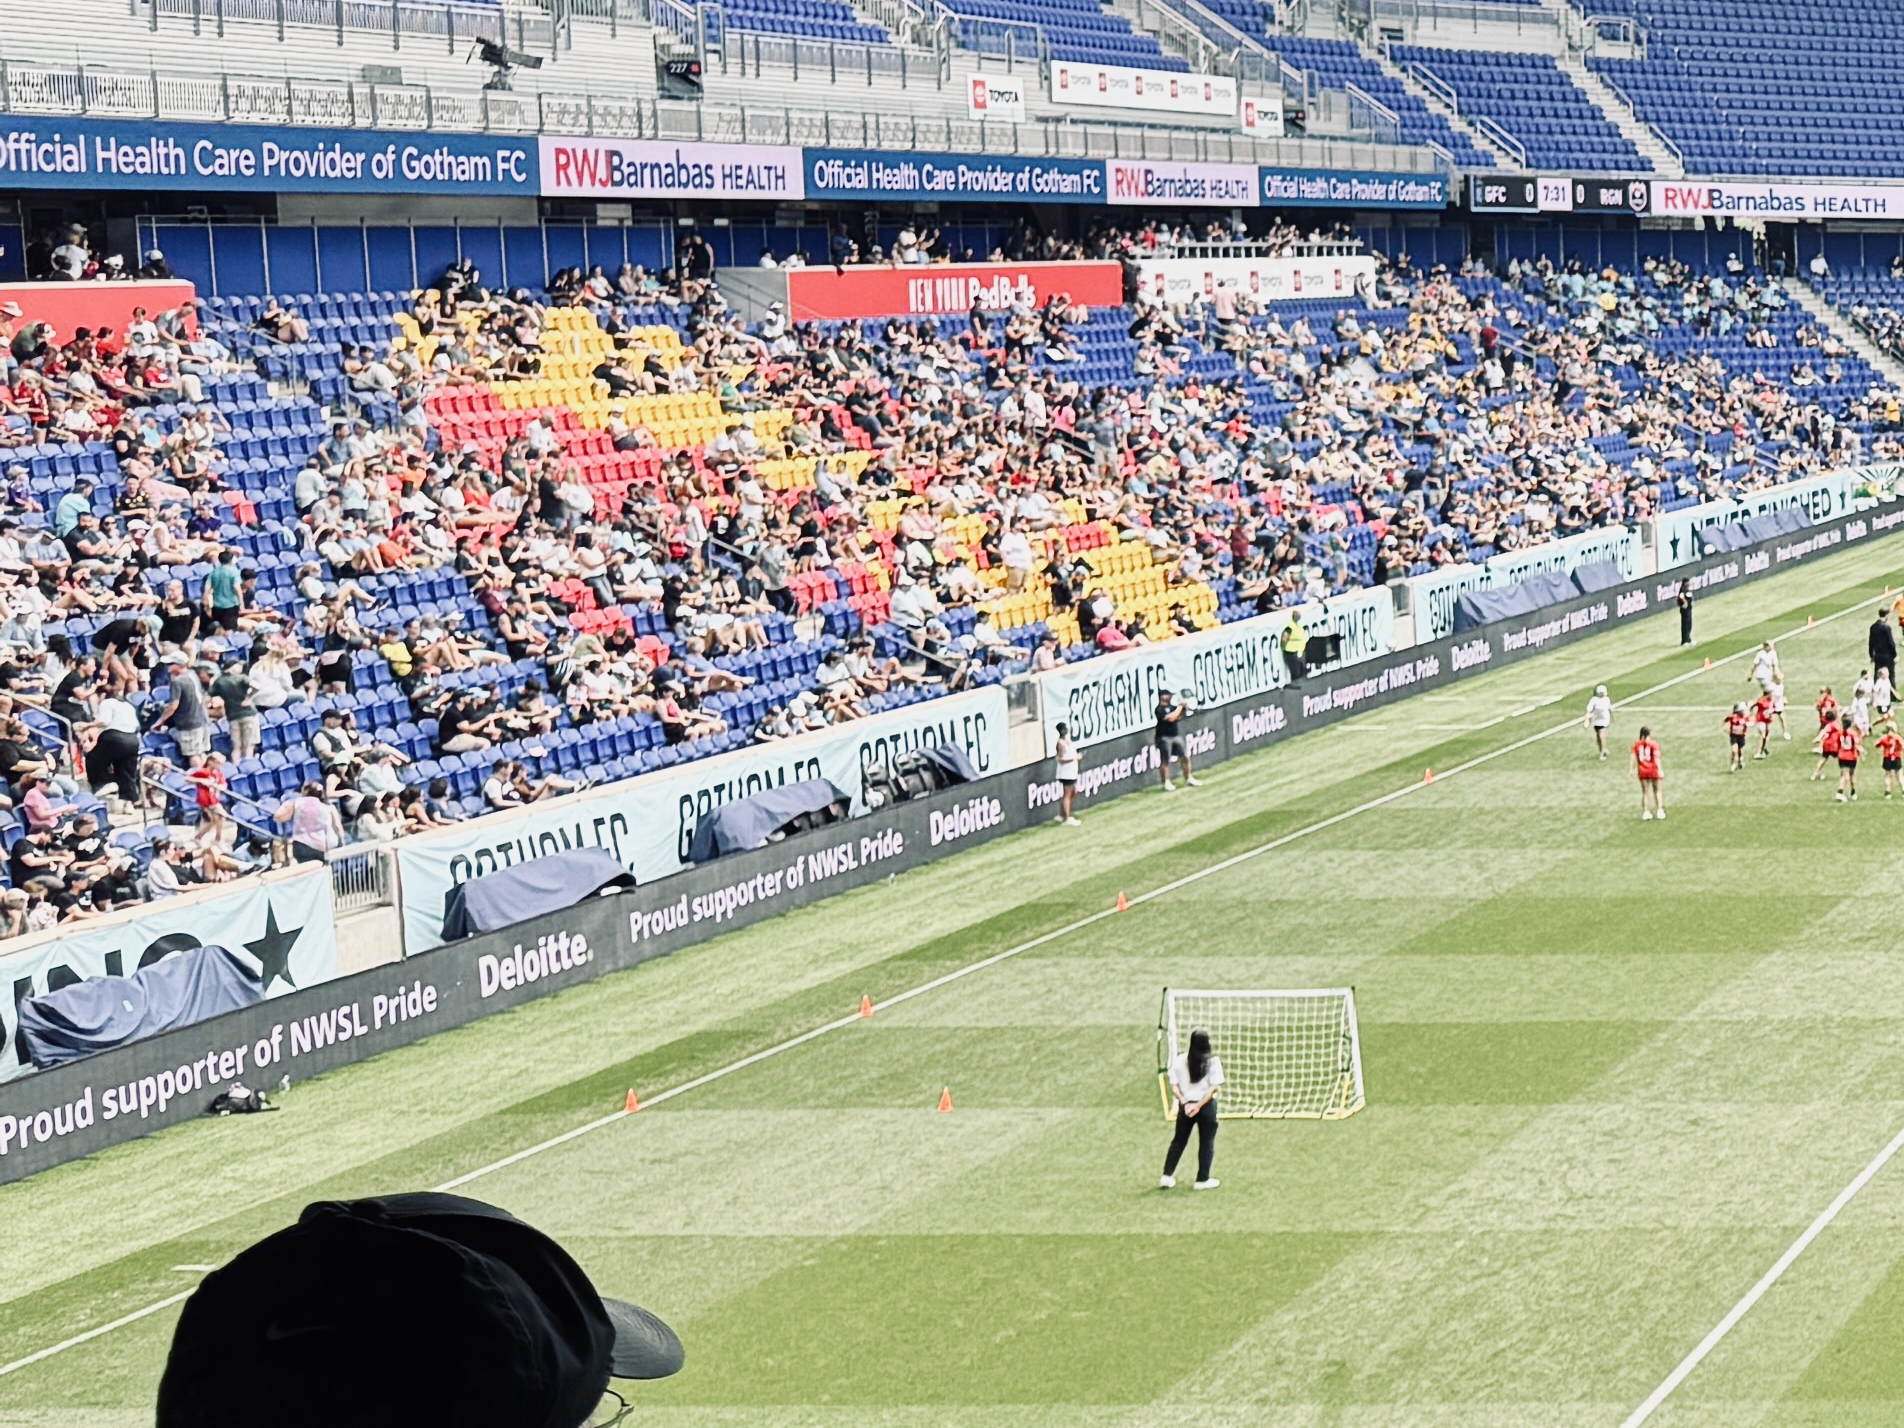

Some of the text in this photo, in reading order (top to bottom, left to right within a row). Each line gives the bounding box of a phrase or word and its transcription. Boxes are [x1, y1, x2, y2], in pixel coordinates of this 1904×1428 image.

[989, 89, 1020, 103] TOYOTA
[94, 135, 187, 176] Health
[193, 139, 256, 177] Care
[261, 141, 367, 179] Provider
[372, 144, 397, 180] of
[401, 146, 492, 183] Gotham
[497, 149, 528, 183] FC
[721, 163, 786, 191] HEALTH
[1543, 188, 1566, 203] 7:31
[1814, 196, 1887, 213] HEALTH
[1362, 606, 1377, 654] FC
[1193, 637, 1257, 705] GOTHAM
[1261, 633, 1281, 690] FC
[1068, 664, 1144, 742] GOTHAM
[1186, 726, 1217, 758] Pride
[629, 827, 904, 944] Proud supporter of NWSL Pride
[0, 980, 438, 1156] Proud supporter of NWSL Pride
